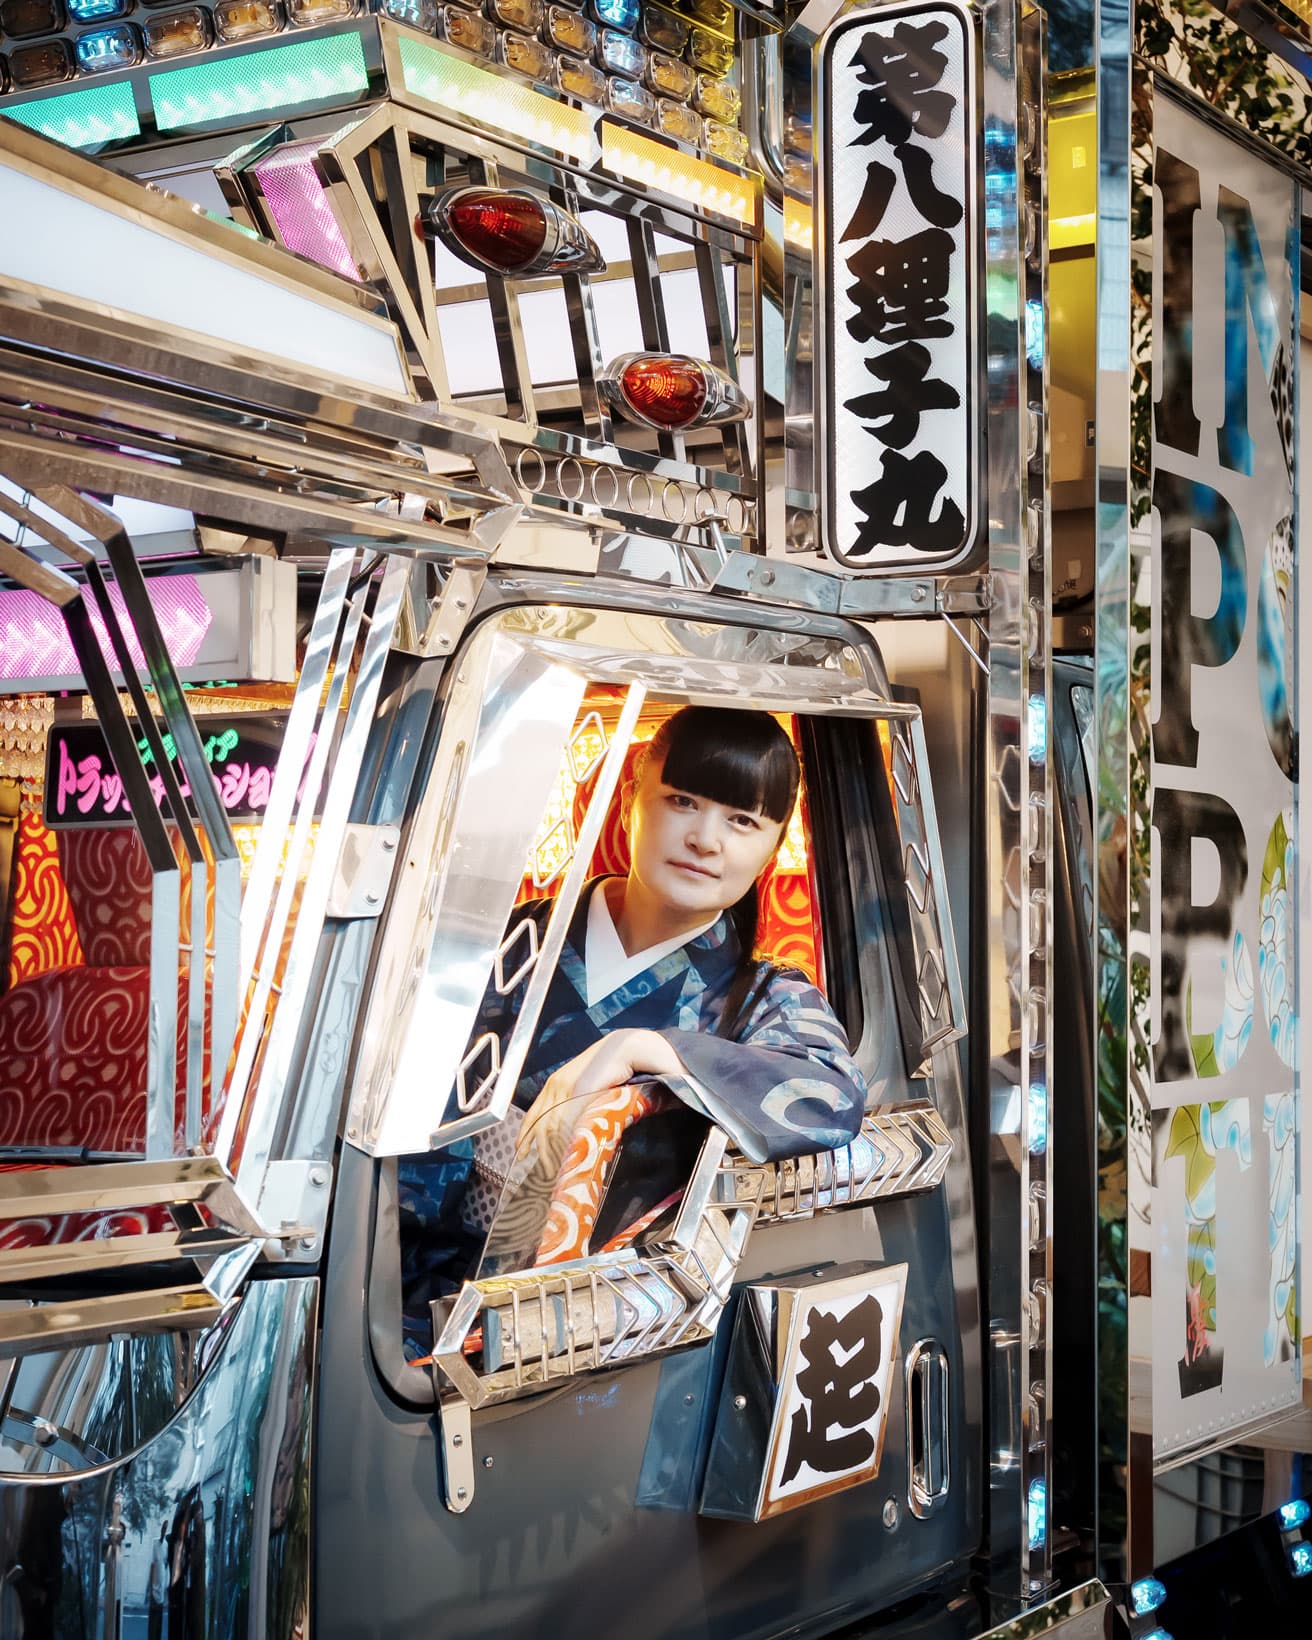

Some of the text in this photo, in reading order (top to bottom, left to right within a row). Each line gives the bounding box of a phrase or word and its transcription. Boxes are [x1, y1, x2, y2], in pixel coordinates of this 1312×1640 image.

[838, 20, 965, 557] 第八理子丸
